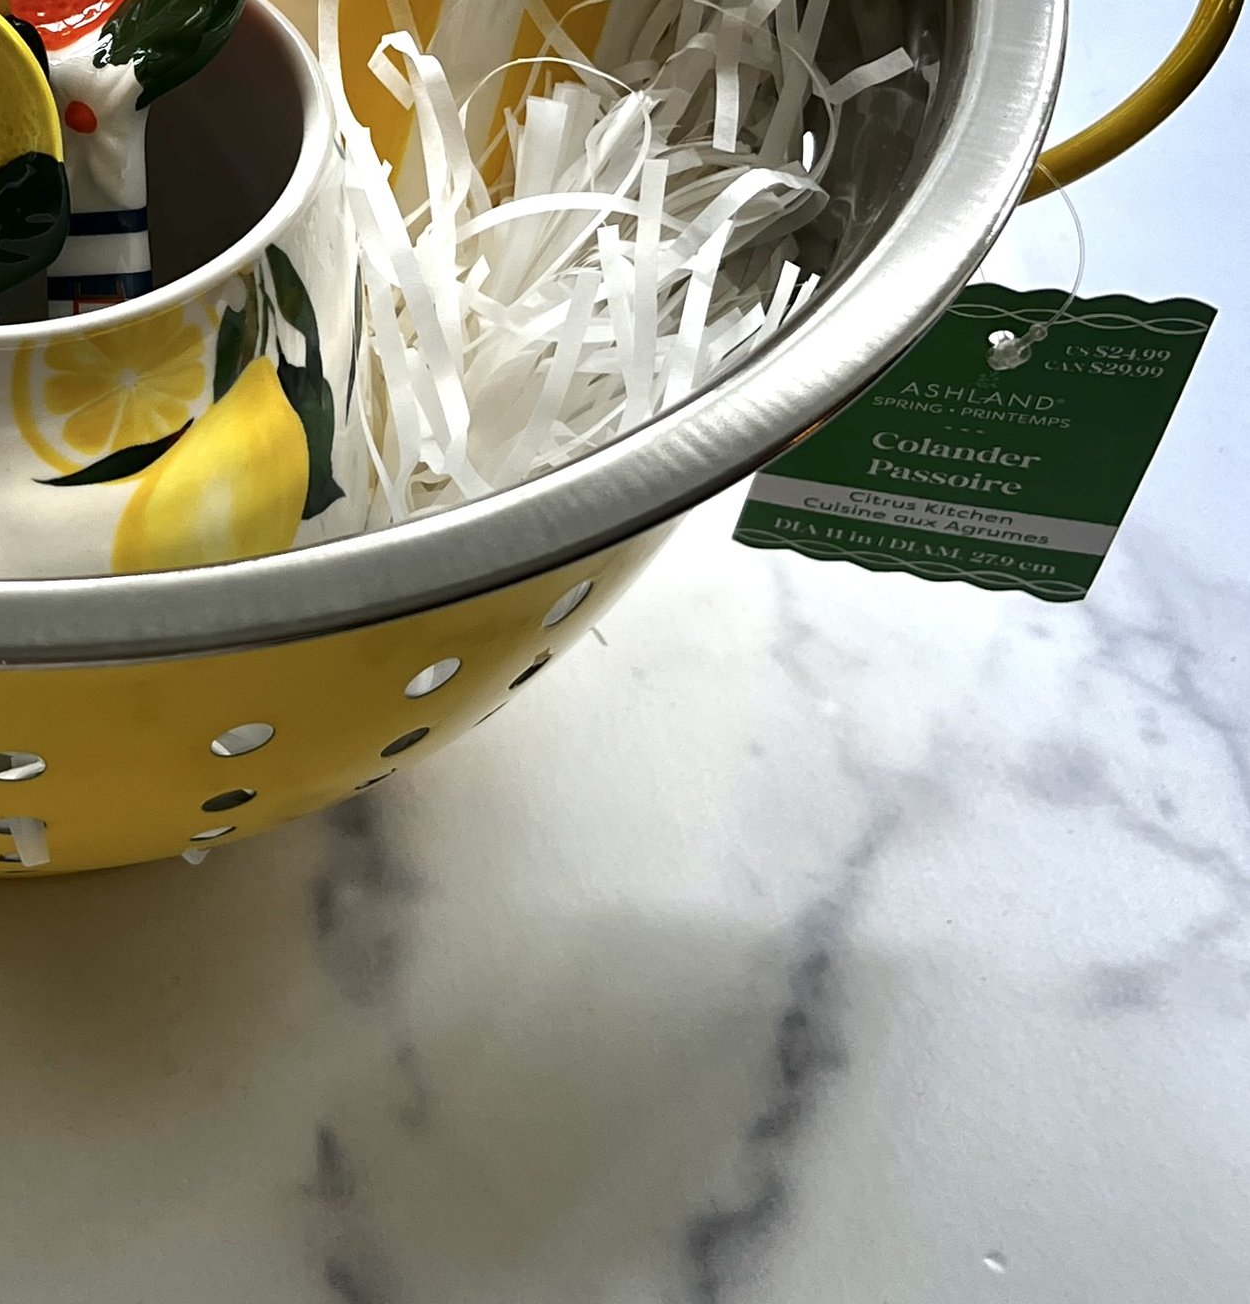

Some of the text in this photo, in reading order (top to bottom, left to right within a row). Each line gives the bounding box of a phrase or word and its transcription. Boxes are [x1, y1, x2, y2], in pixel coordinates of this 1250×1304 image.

[1045, 360, 1165, 378] CAN $29.99
[1065, 345, 1171, 362] US $24.99
[872, 396, 1071, 428] SPRING PRINTEMPS
[872, 431, 1041, 469] Colander
[866, 458, 1022, 496] Passoire
[803, 496, 1049, 545] Cuisine aux Agrumes
[848, 490, 1013, 526] Citrus Kitchen
[849, 529, 872, 545] in
[969, 550, 1015, 567] 27.9
[1018, 560, 1056, 575] cm
